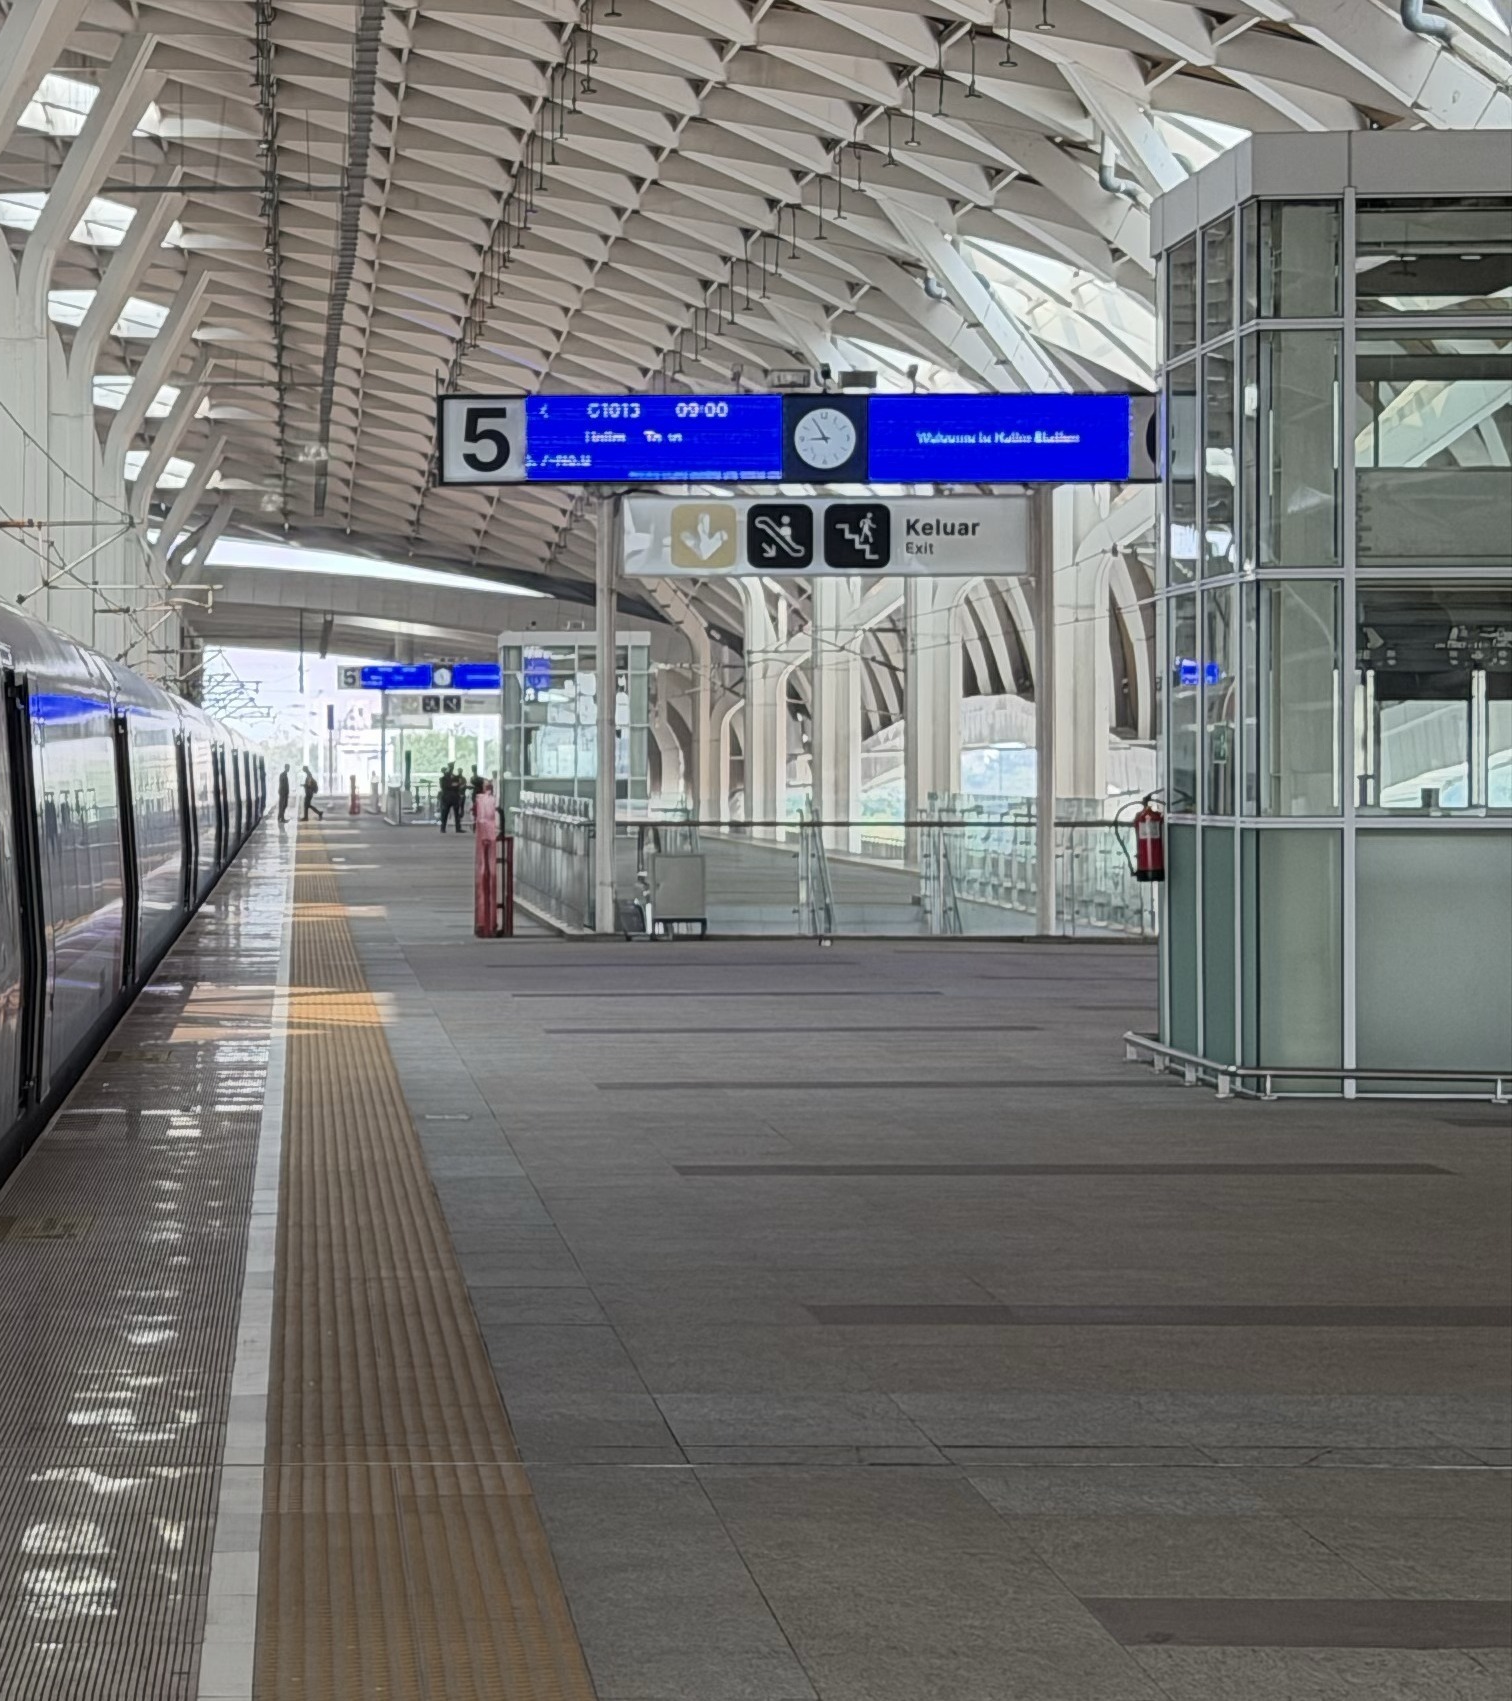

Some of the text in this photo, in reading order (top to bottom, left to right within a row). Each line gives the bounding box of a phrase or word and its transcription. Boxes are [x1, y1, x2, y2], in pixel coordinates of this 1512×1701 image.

[675, 401, 729, 418] 09:00
[462, 407, 511, 473] 5
[906, 518, 981, 537] Keluar
[905, 541, 934, 555] Exit
